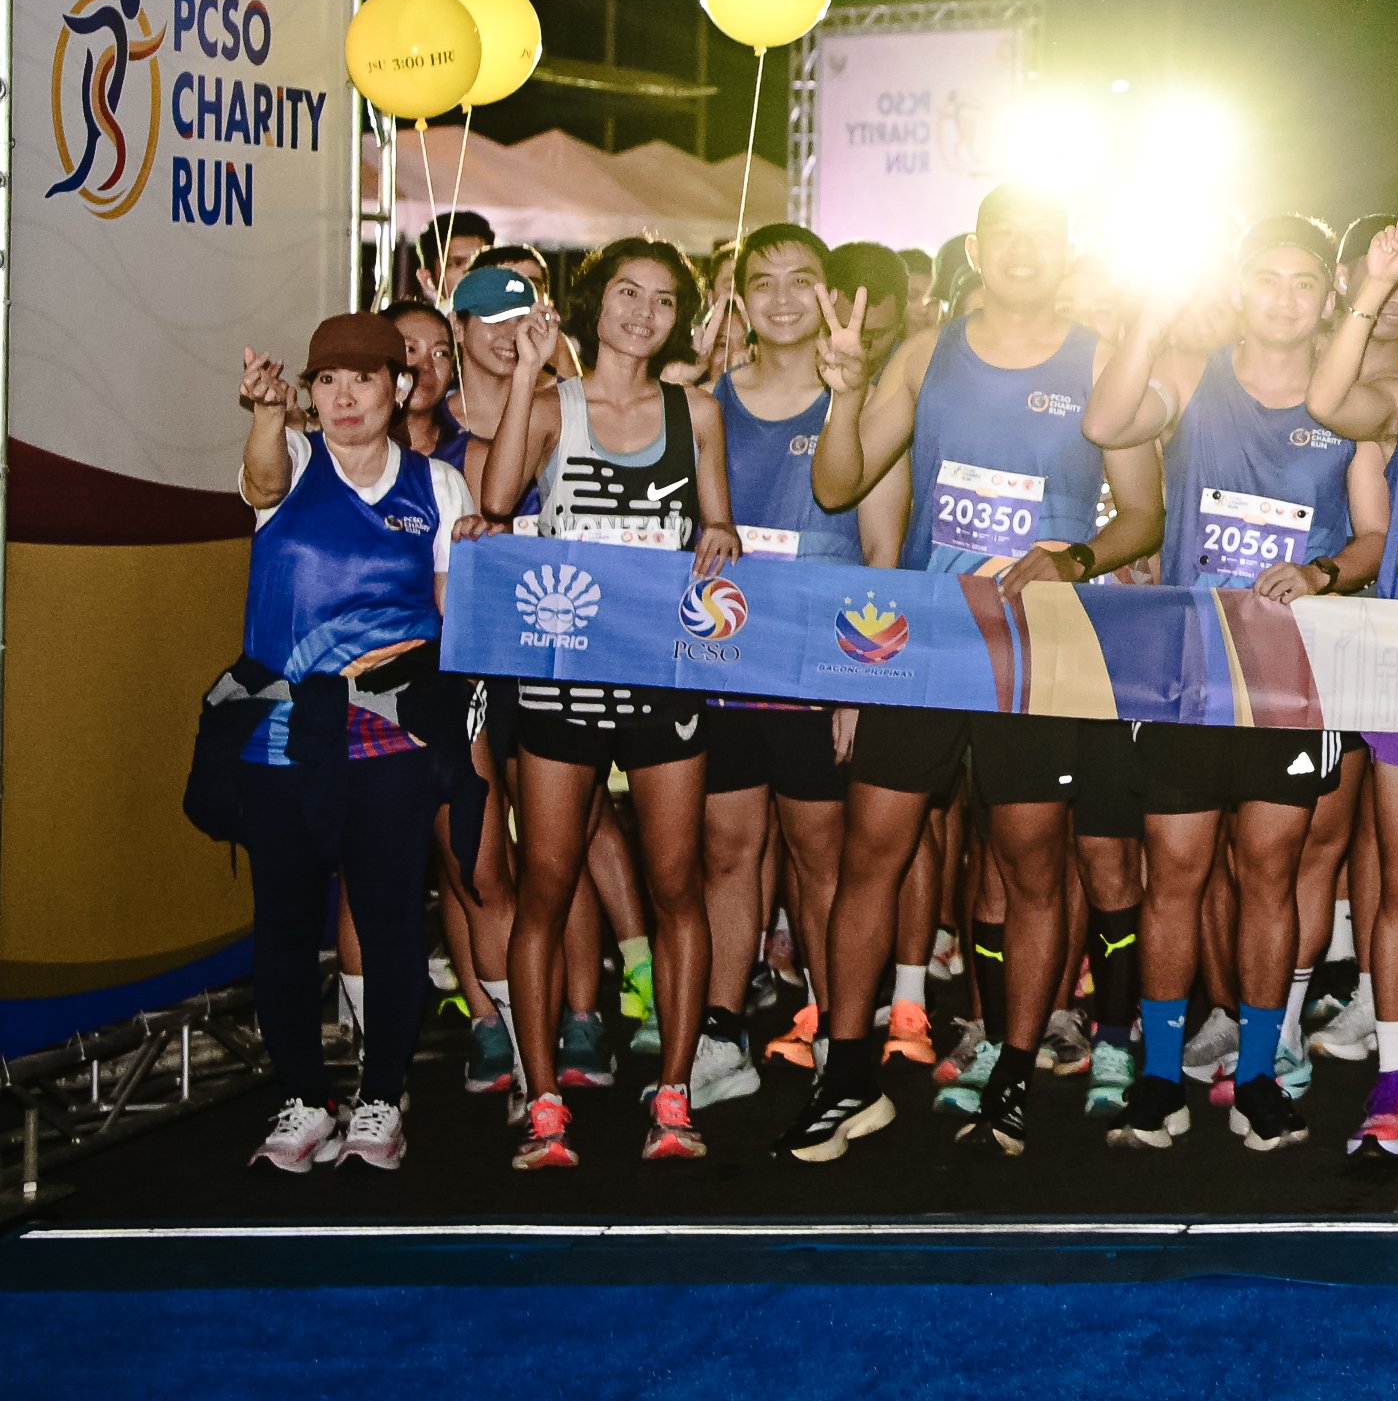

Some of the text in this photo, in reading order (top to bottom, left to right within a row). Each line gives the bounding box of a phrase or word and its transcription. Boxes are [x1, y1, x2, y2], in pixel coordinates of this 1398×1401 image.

[392, 56, 425, 72] 3:00
[430, 50, 455, 67] HR
[172, 71, 326, 151] CHARITY
[172, 156, 253, 226] RUN
[939, 495, 1032, 535] 20350
[1203, 524, 1295, 563] 20561
[673, 639, 740, 662] PCSO
